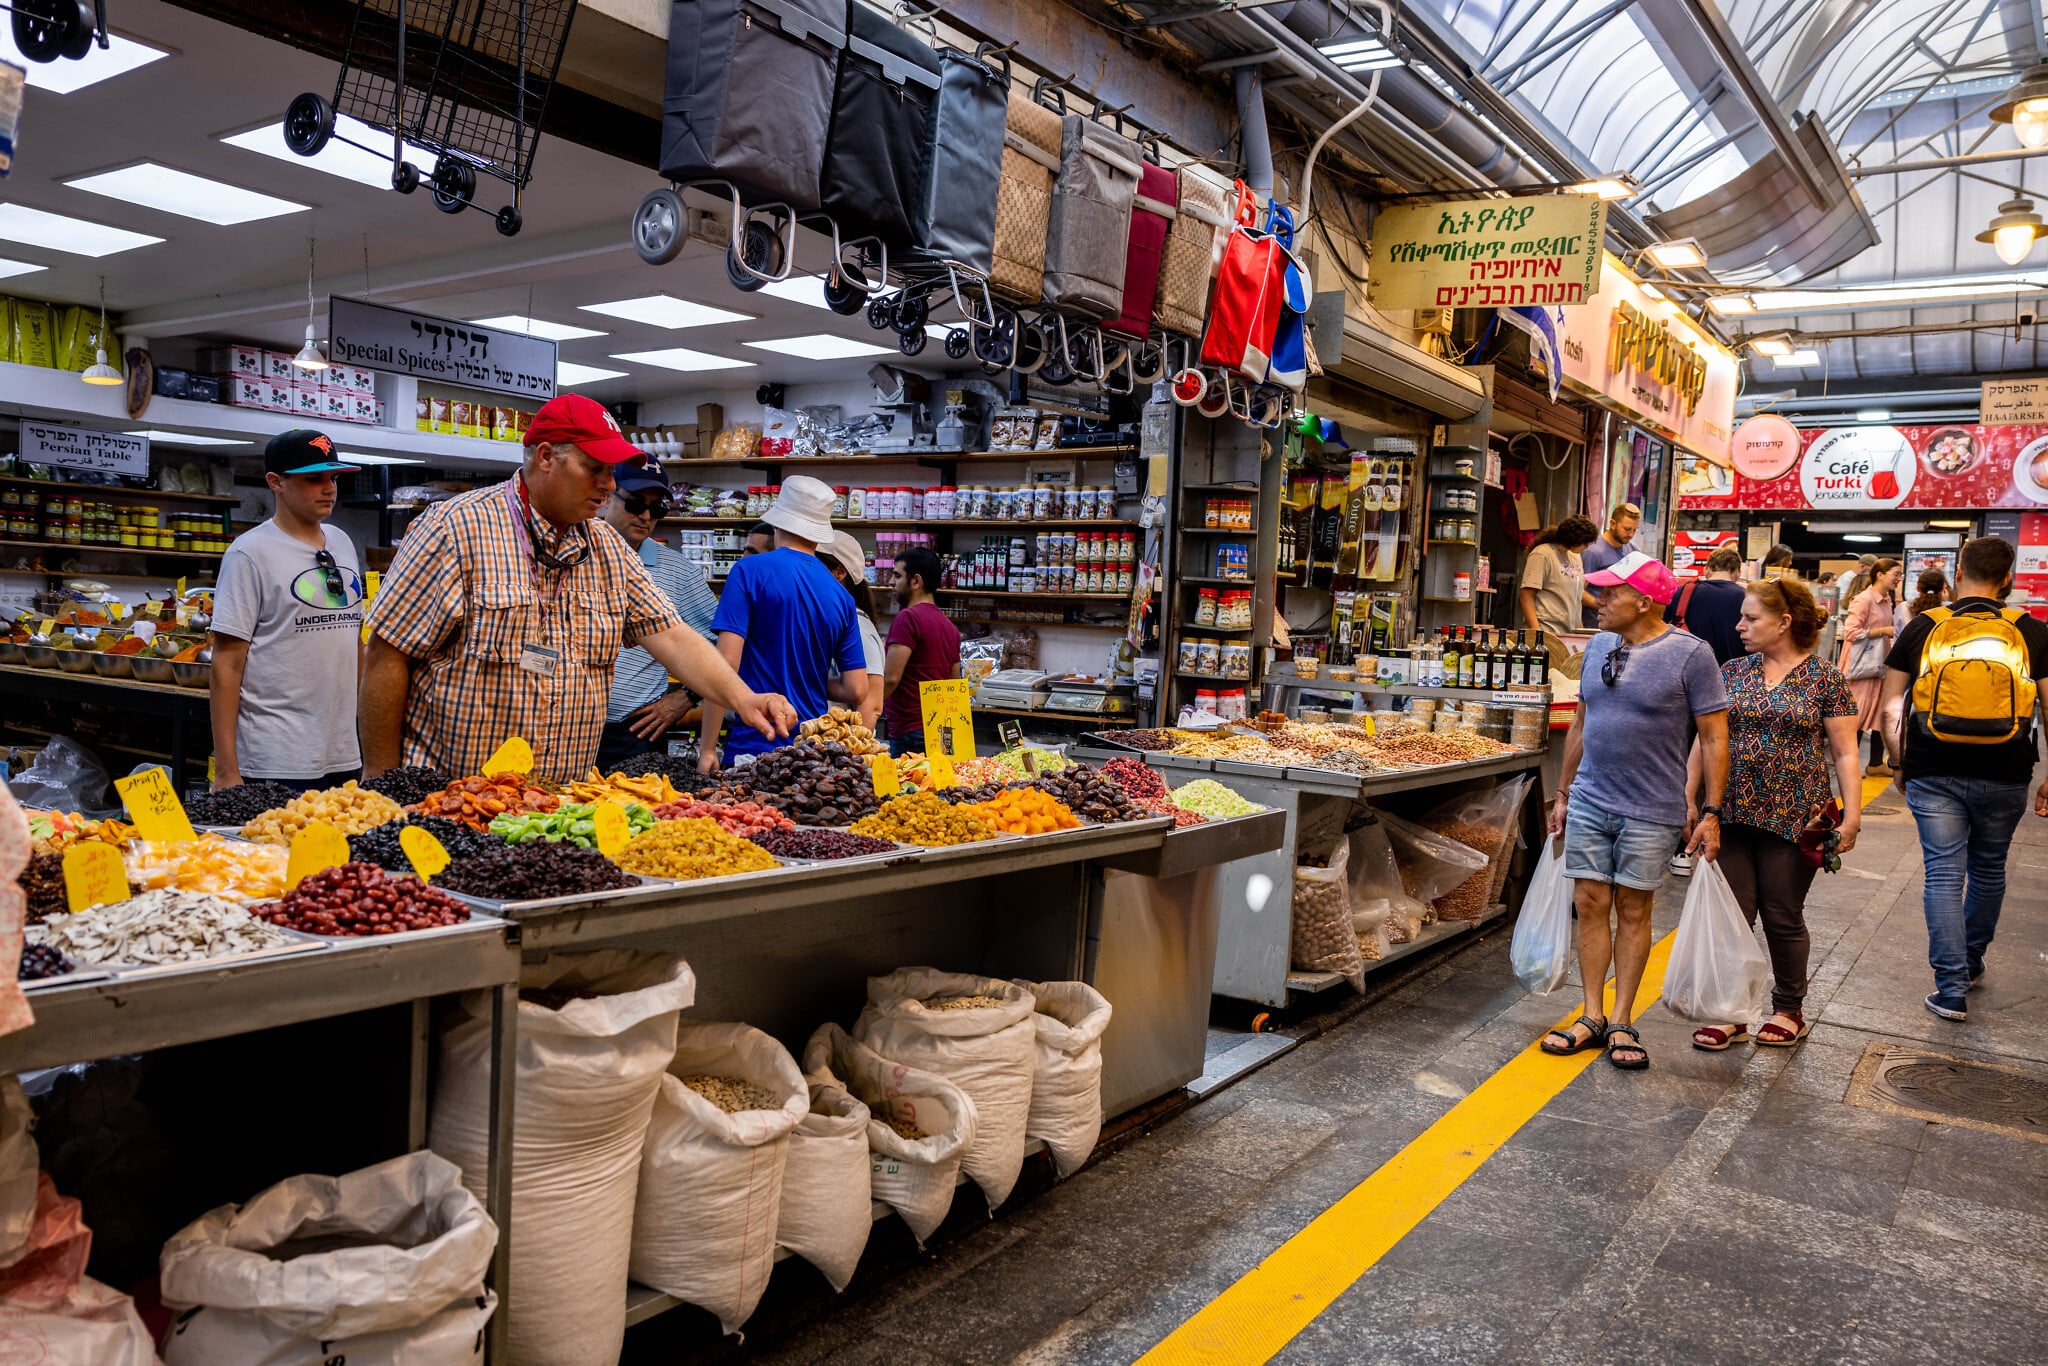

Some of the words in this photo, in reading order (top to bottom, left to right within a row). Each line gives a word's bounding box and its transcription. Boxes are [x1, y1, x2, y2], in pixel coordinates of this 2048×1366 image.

[1437, 205, 1535, 235] ኢትዮጵያ
[1469, 258, 1562, 281] איתיופיה
[1436, 283, 1525, 306] תבלינים
[1529, 282, 1583, 304] חנות
[335, 336, 394, 364] Special
[454, 360, 490, 381] תבלין
[494, 365, 513, 383] של
[516, 373, 552, 391] איכות
[1989, 384, 2039, 397] האפרסק
[1985, 411, 2045, 422] HA-AFARSEK
[29, 427, 78, 443] הפרסי
[85, 434, 141, 451] השולחן
[40, 441, 91, 456] Persian
[95, 447, 132, 461] Table
[1814, 437, 1838, 463] למהדרין
[1829, 460, 1869, 475] Café
[1814, 475, 1862, 489] Turki
[1349, 498, 1361, 533] Outre
[1324, 515, 1337, 548] Outre
[295, 614, 336, 625] UNDER
